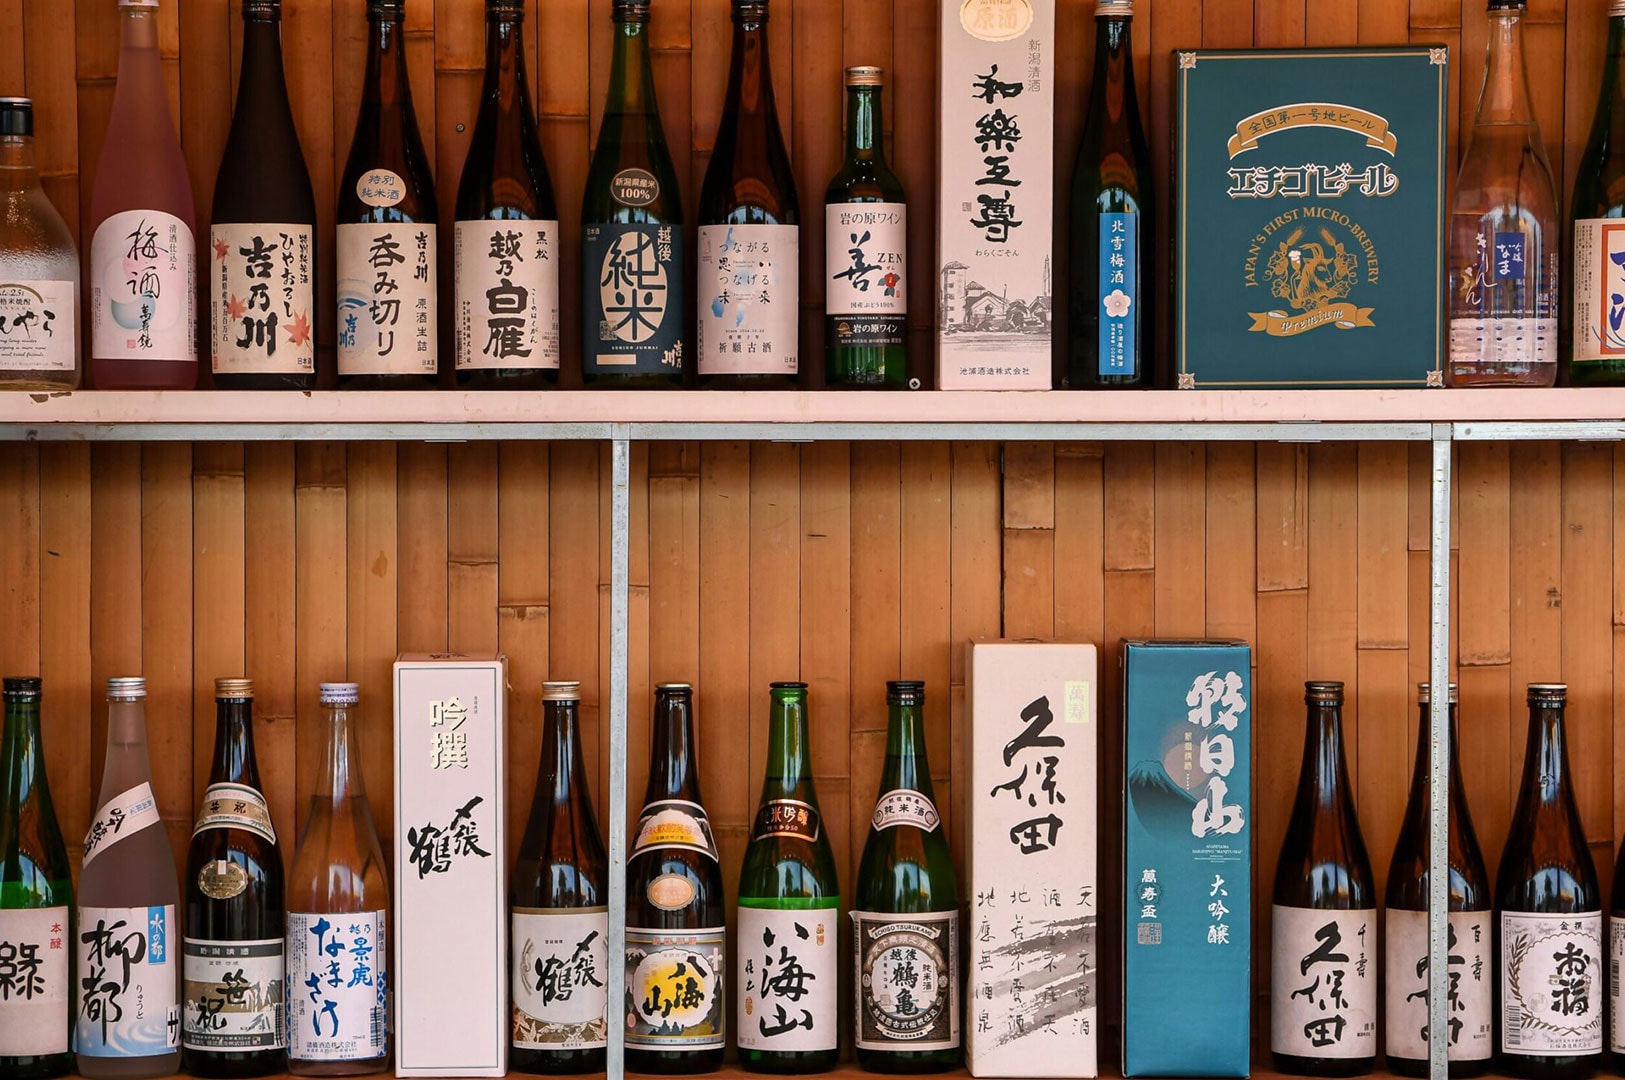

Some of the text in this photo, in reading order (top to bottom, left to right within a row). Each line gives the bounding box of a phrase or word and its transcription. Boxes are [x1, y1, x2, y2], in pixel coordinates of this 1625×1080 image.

[1028, 39, 1041, 92] 新潟清酒
[1248, 108, 1375, 134] 全国第一号地ビール
[362, 188, 400, 200] 純米酒
[368, 174, 395, 185] 特別
[615, 177, 656, 189] 新潟県産米
[620, 188, 651, 200] 100%
[1227, 162, 1399, 198] エチゴビール
[840, 212, 901, 225] 岩の原ワイン
[125, 218, 169, 299] 梅酒
[168, 223, 178, 272] 清酒仕込み
[414, 231, 428, 283] 吉乃川
[534, 231, 549, 260] 黒松
[657, 226, 672, 262] 越後
[719, 241, 770, 253] つながる
[877, 252, 903, 264] ZEN
[975, 249, 1020, 258] わらくごそん
[1110, 219, 1126, 285] 北雪梅酒
[1245, 207, 1379, 286] JAPAN'S FIRST MICRO-BREWERY
[1496, 244, 1511, 276] なま
[279, 232, 295, 318] ひやおろし
[718, 257, 771, 272] 思い
[719, 274, 770, 286] つなげる
[236, 236, 278, 357] 吉乃川
[368, 233, 405, 357] 呑み切り
[483, 230, 532, 359] 越乃白雁
[602, 231, 666, 341] 純米
[718, 289, 771, 304] 未来
[416, 298, 427, 352] 原酒生詰
[853, 323, 898, 334] 岩の原ワイン
[1281, 309, 1344, 333] Premium
[959, 366, 1031, 376] 池浦酒造株式会社
[990, 695, 1066, 855] 久保田
[764, 805, 809, 826] 米吟醸
[884, 803, 925, 817] 純米酒
[1207, 874, 1230, 944] 大吟醸
[150, 913, 165, 960] 水の都
[890, 948, 918, 961] 越後
[347, 936, 374, 988] 景虎
[759, 921, 816, 1038] 八海山
[922, 963, 933, 991] 純米酒
[643, 956, 708, 1018] 八海山
[1291, 920, 1350, 1047] 久保田
[136, 984, 144, 1020] りゅうと
